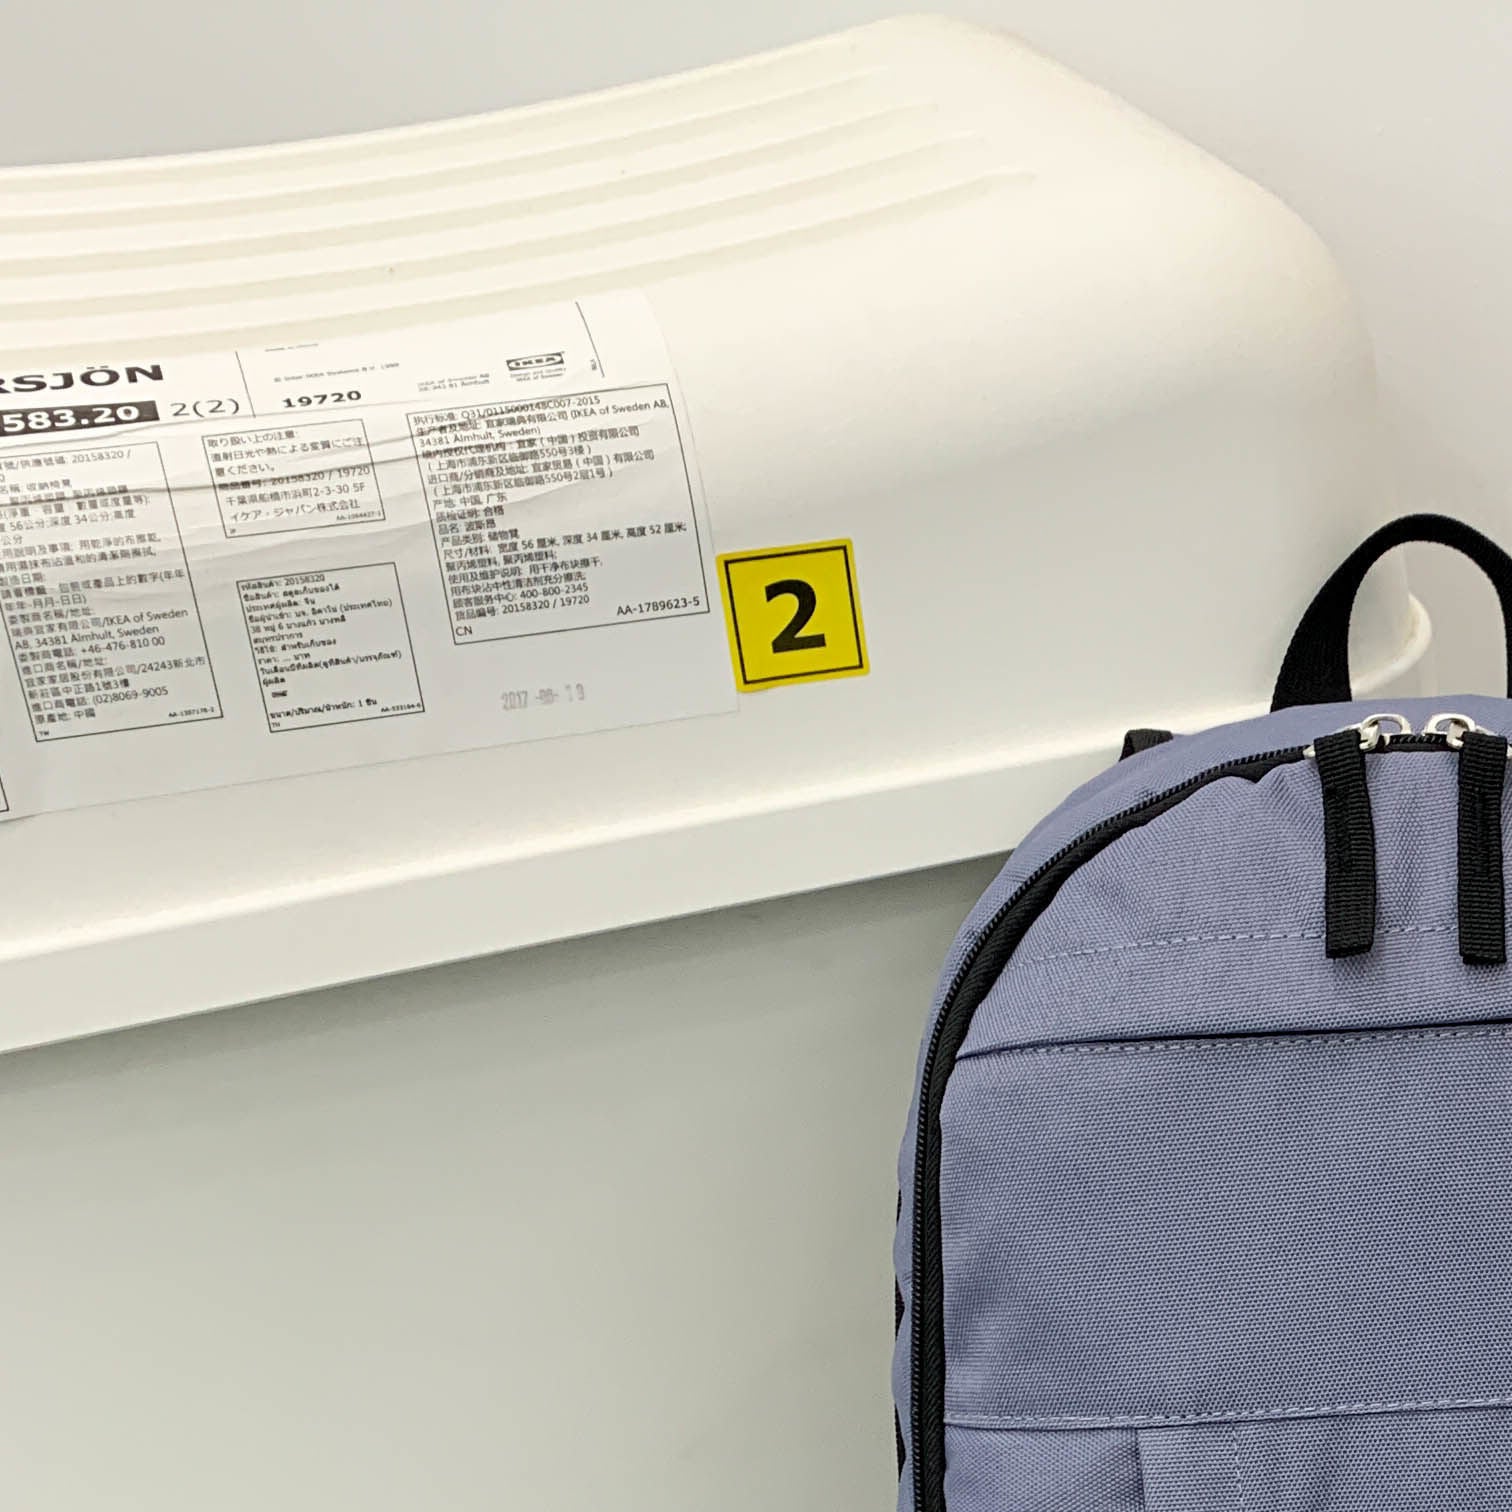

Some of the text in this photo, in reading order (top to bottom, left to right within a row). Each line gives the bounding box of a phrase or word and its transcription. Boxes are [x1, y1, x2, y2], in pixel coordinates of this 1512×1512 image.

[283, 389, 362, 409] 19720
[611, 400, 650, 413] Sweden
[3, 398, 241, 434] 583.20 2(2)
[419, 435, 449, 447] 34381
[497, 425, 540, 438] Sweden)
[521, 539, 534, 550] 56
[585, 531, 598, 542] 34
[648, 523, 661, 534] 52
[519, 582, 588, 600] 400-800-2345
[501, 599, 550, 614] 20158320
[559, 594, 590, 607] 19720
[615, 595, 700, 616] AA-1789623-5
[132, 612, 144, 622] of
[146, 607, 188, 621] Sweden
[764, 579, 827, 655] 2
[35, 635, 67, 648] 34381
[116, 624, 160, 638] Sweden
[455, 625, 472, 636] CN
[91, 685, 169, 704] (02)8069-9005
